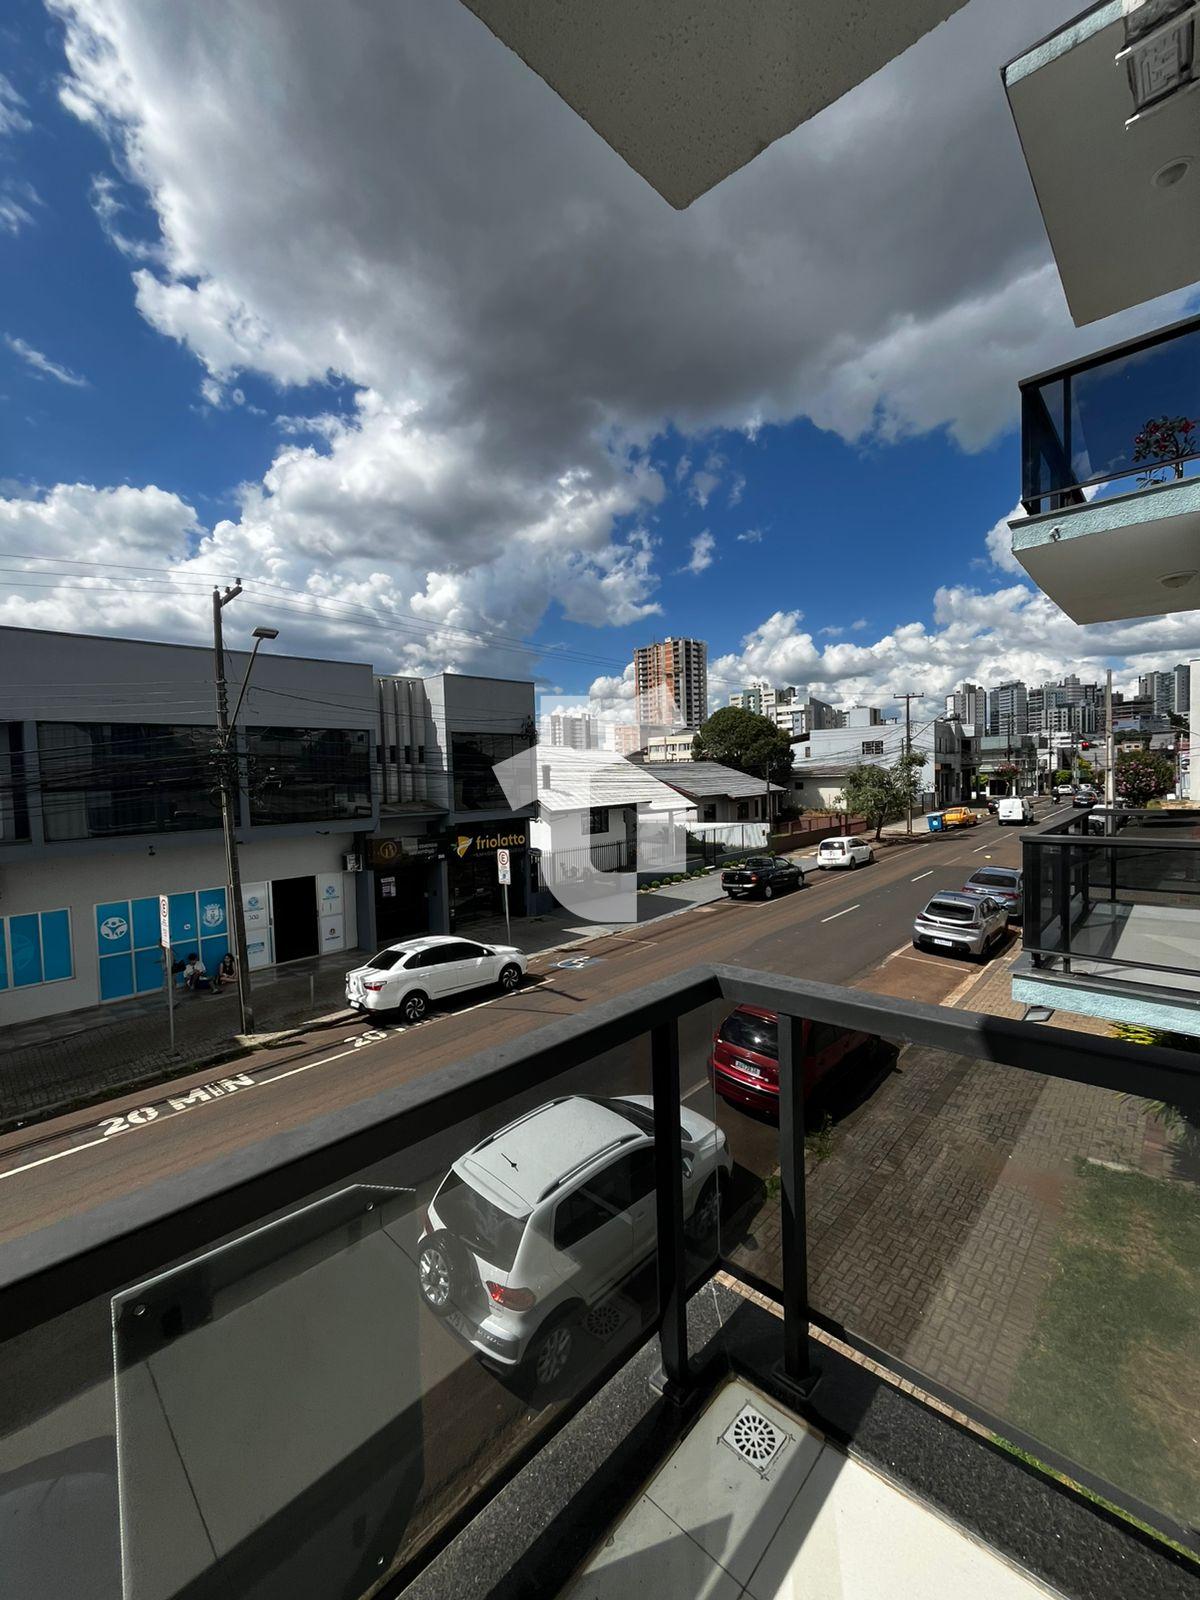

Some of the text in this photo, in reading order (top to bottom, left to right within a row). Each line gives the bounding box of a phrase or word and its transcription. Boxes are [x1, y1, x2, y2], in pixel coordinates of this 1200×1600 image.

[476, 833, 526, 850] friolatto
[98, 1073, 255, 1136] 20 MIN
